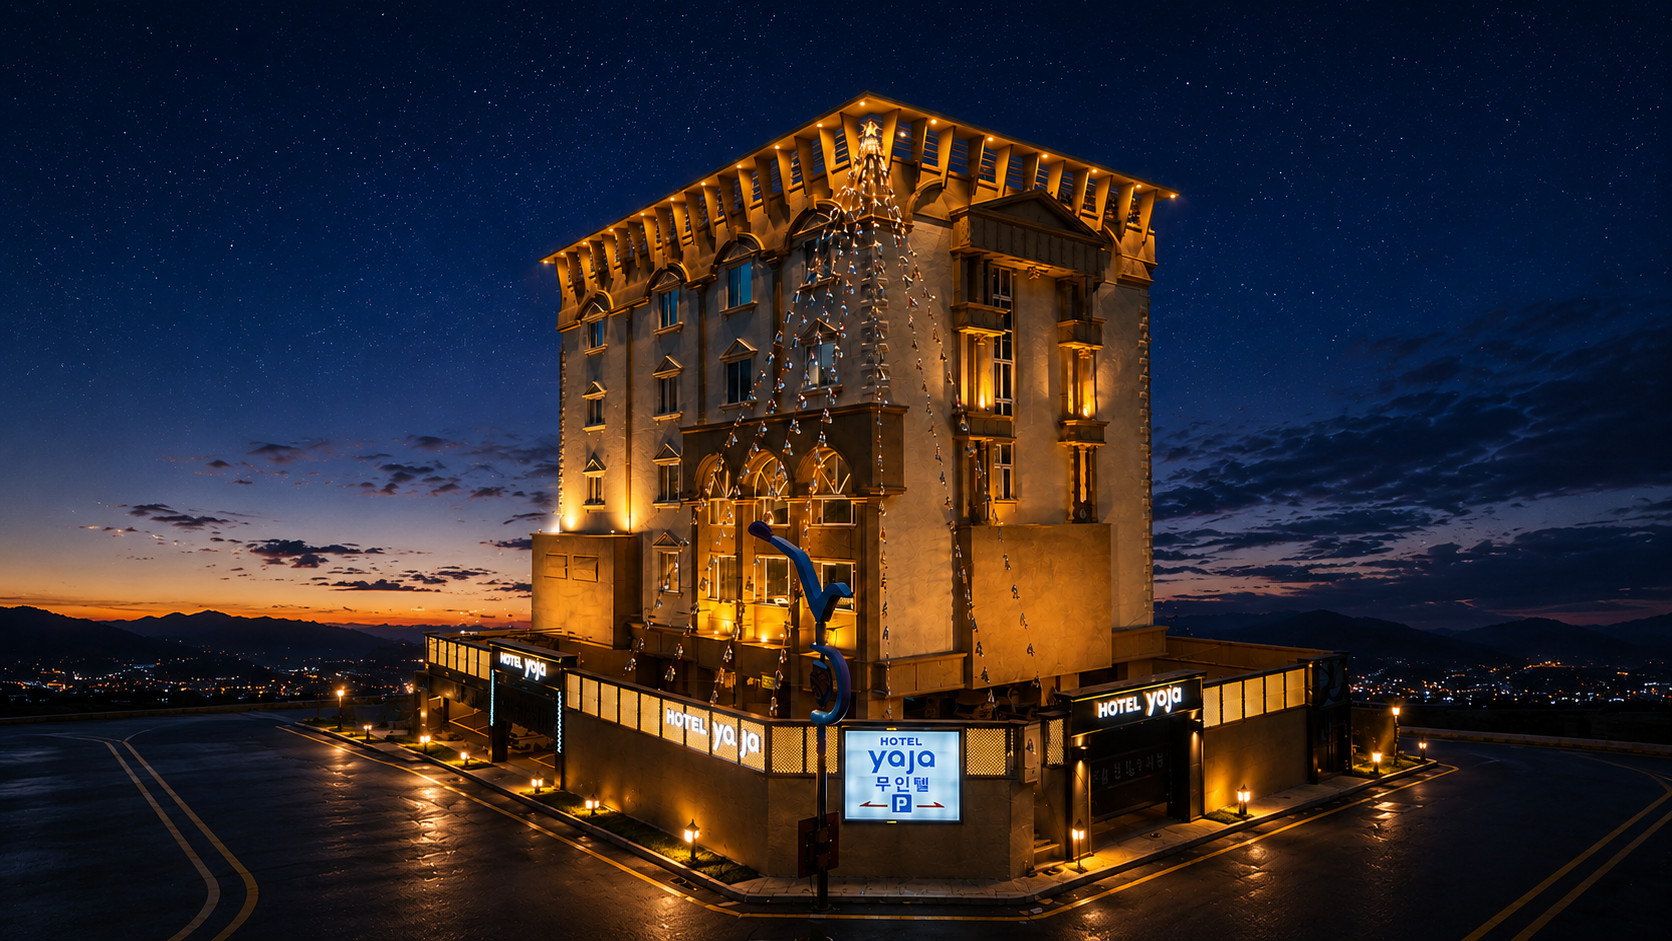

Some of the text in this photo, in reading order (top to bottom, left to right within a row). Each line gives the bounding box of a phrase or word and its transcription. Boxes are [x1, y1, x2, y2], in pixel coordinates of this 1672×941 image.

[500, 652, 523, 669] HOTEL
[1097, 696, 1141, 718] HOTEL
[666, 709, 708, 735] HOTEL
[880, 737, 922, 746] HOTEL
[867, 750, 935, 775] yaja
